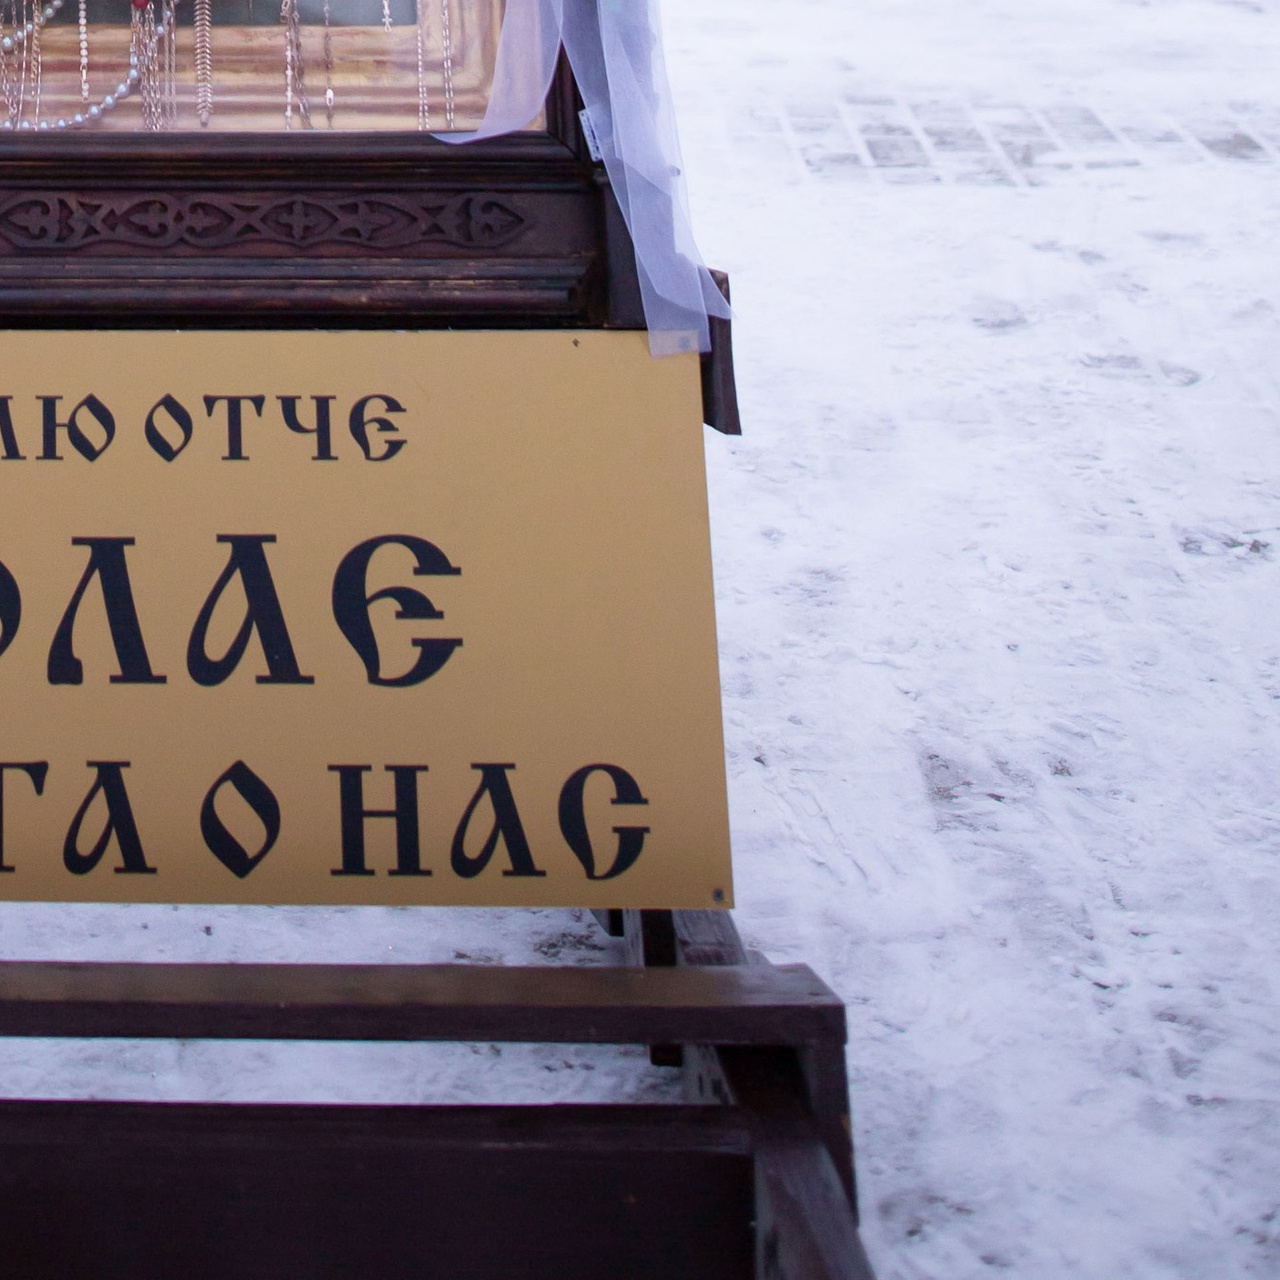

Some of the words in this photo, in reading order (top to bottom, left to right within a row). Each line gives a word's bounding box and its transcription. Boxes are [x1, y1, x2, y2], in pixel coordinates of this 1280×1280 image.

[143, 393, 409, 464] ОТЧЕ
[198, 759, 282, 881] О
[326, 761, 652, 883] НАС
